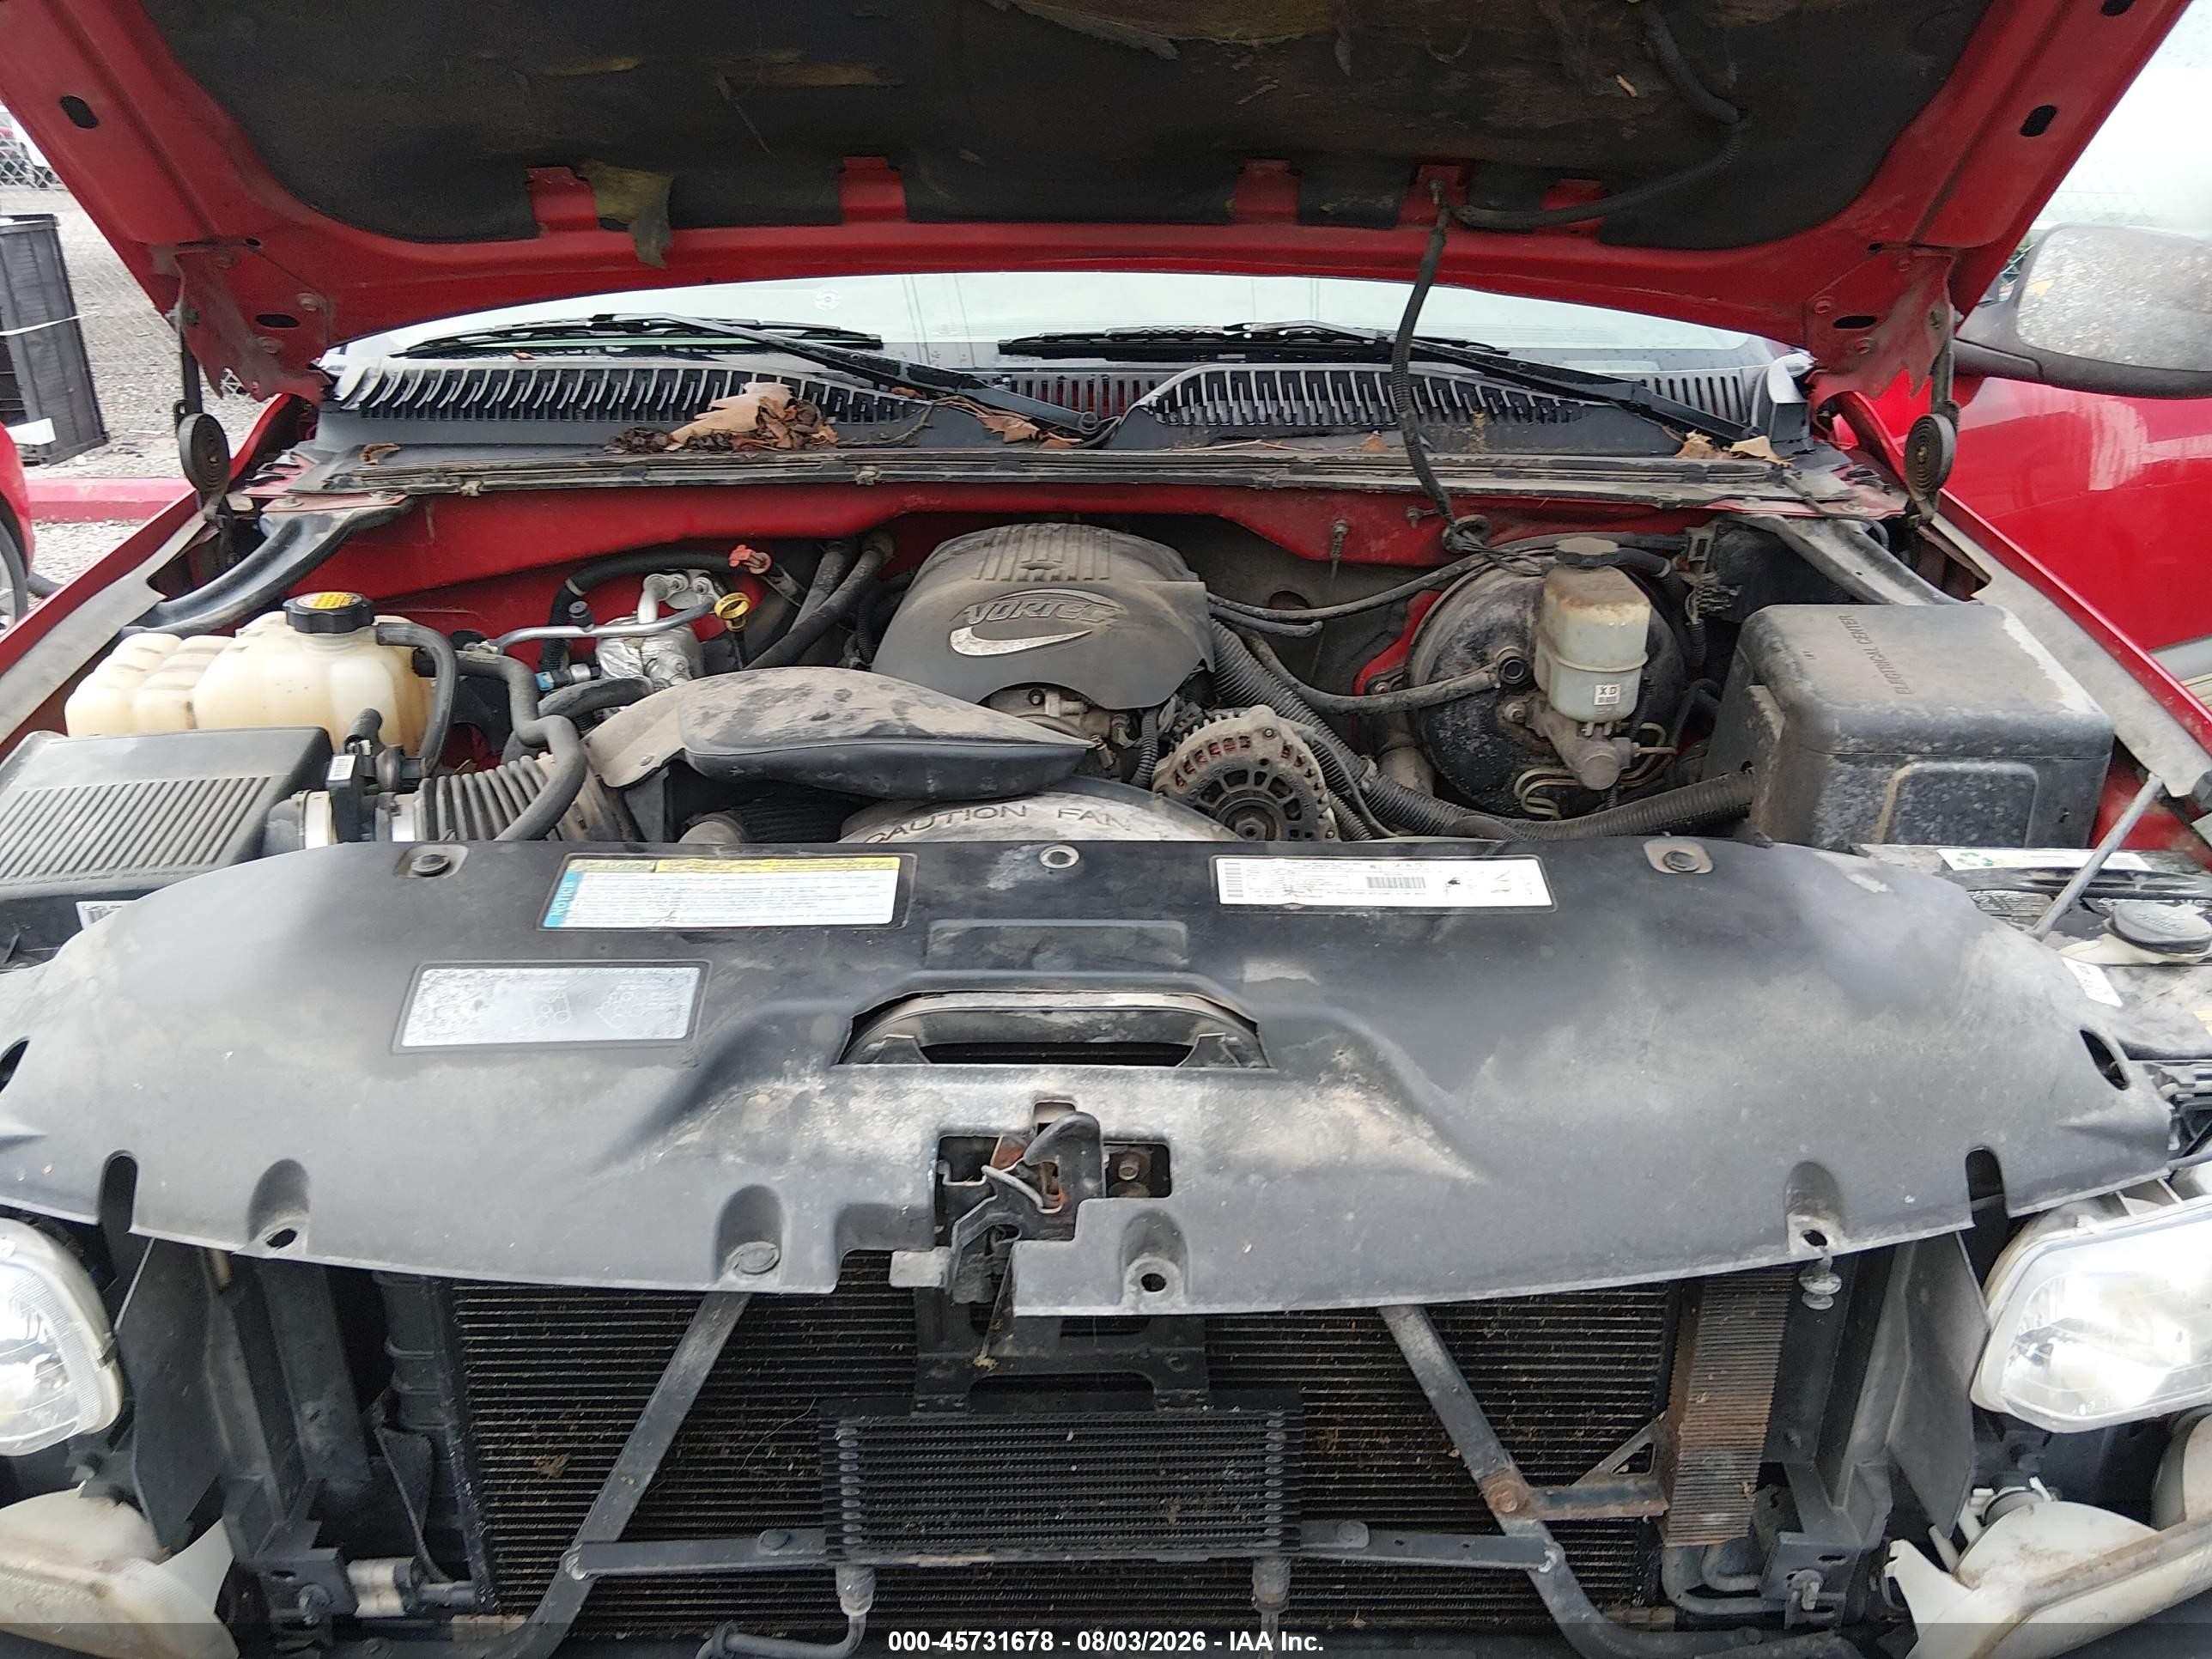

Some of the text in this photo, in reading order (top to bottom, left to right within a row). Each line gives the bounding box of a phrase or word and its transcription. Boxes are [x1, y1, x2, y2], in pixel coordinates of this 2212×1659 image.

[1837, 615, 1874, 645] CENTER
[865, 805, 1133, 843] CAUTION FAN
